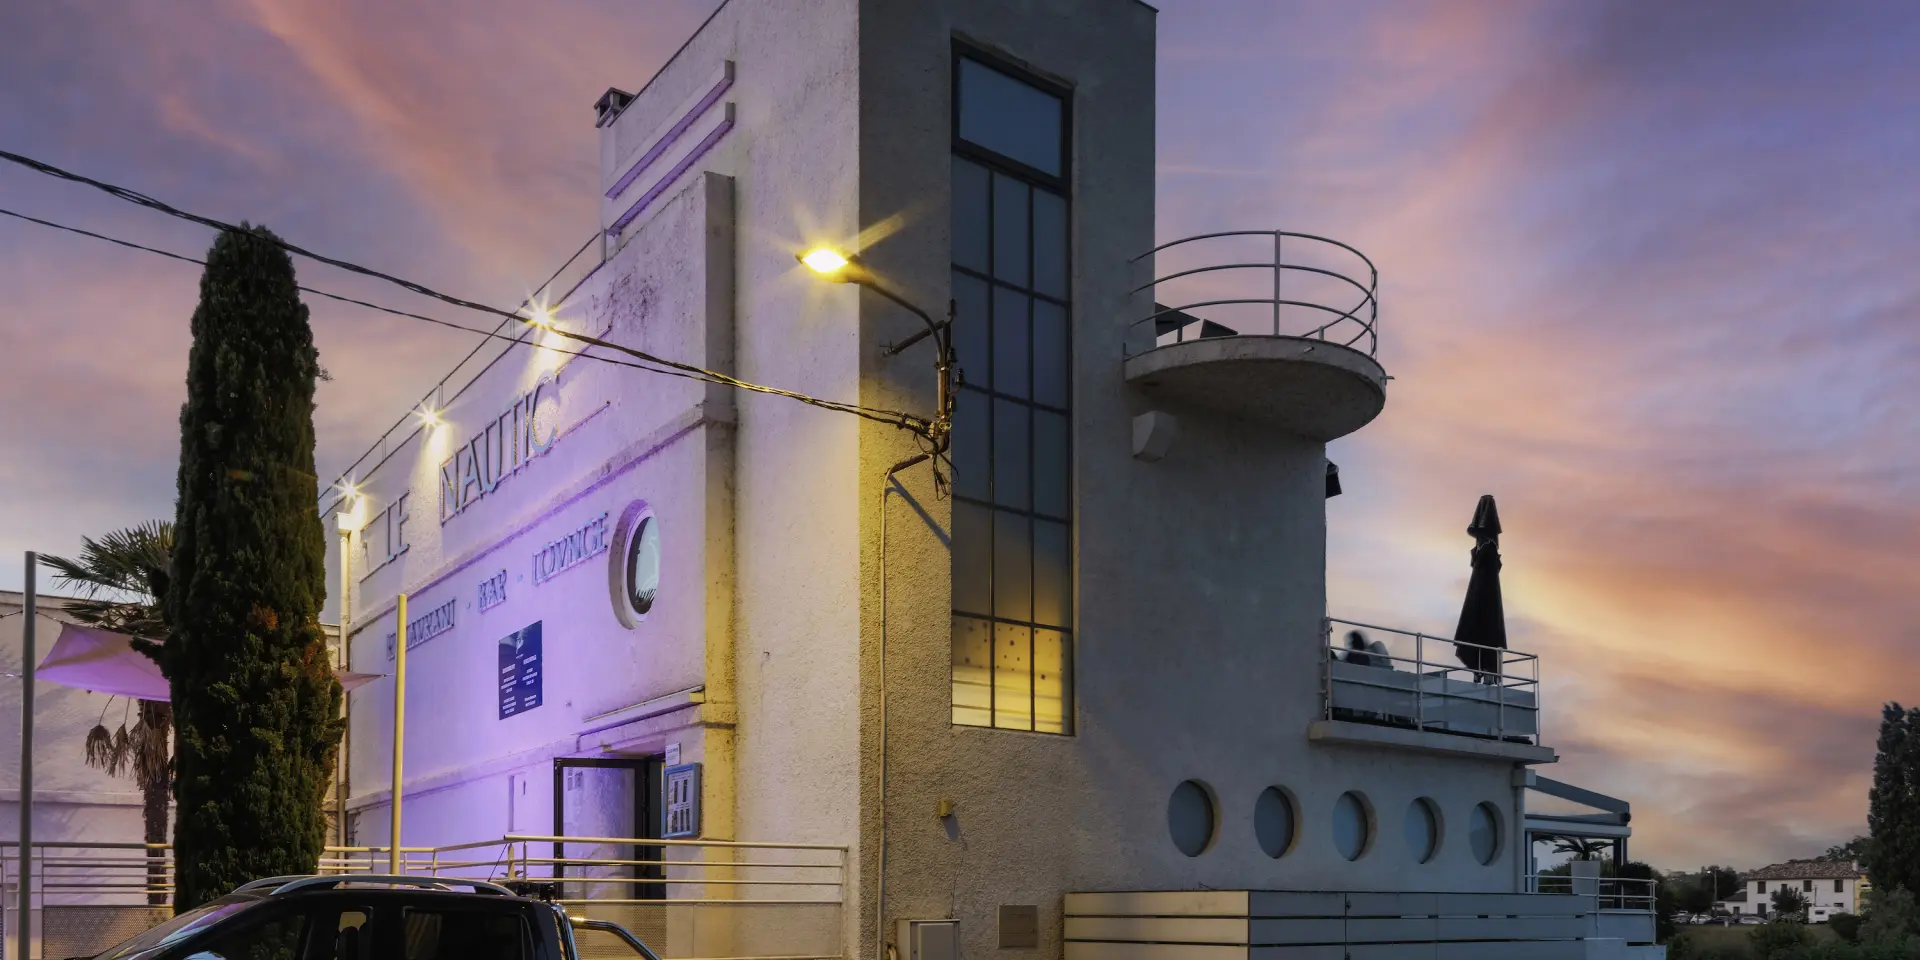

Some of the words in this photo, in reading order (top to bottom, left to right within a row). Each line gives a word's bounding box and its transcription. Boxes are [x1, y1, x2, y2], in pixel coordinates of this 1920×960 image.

[386, 492, 410, 563] LE
[439, 371, 560, 526] NAUTIC
[478, 569, 506, 614] BAR
